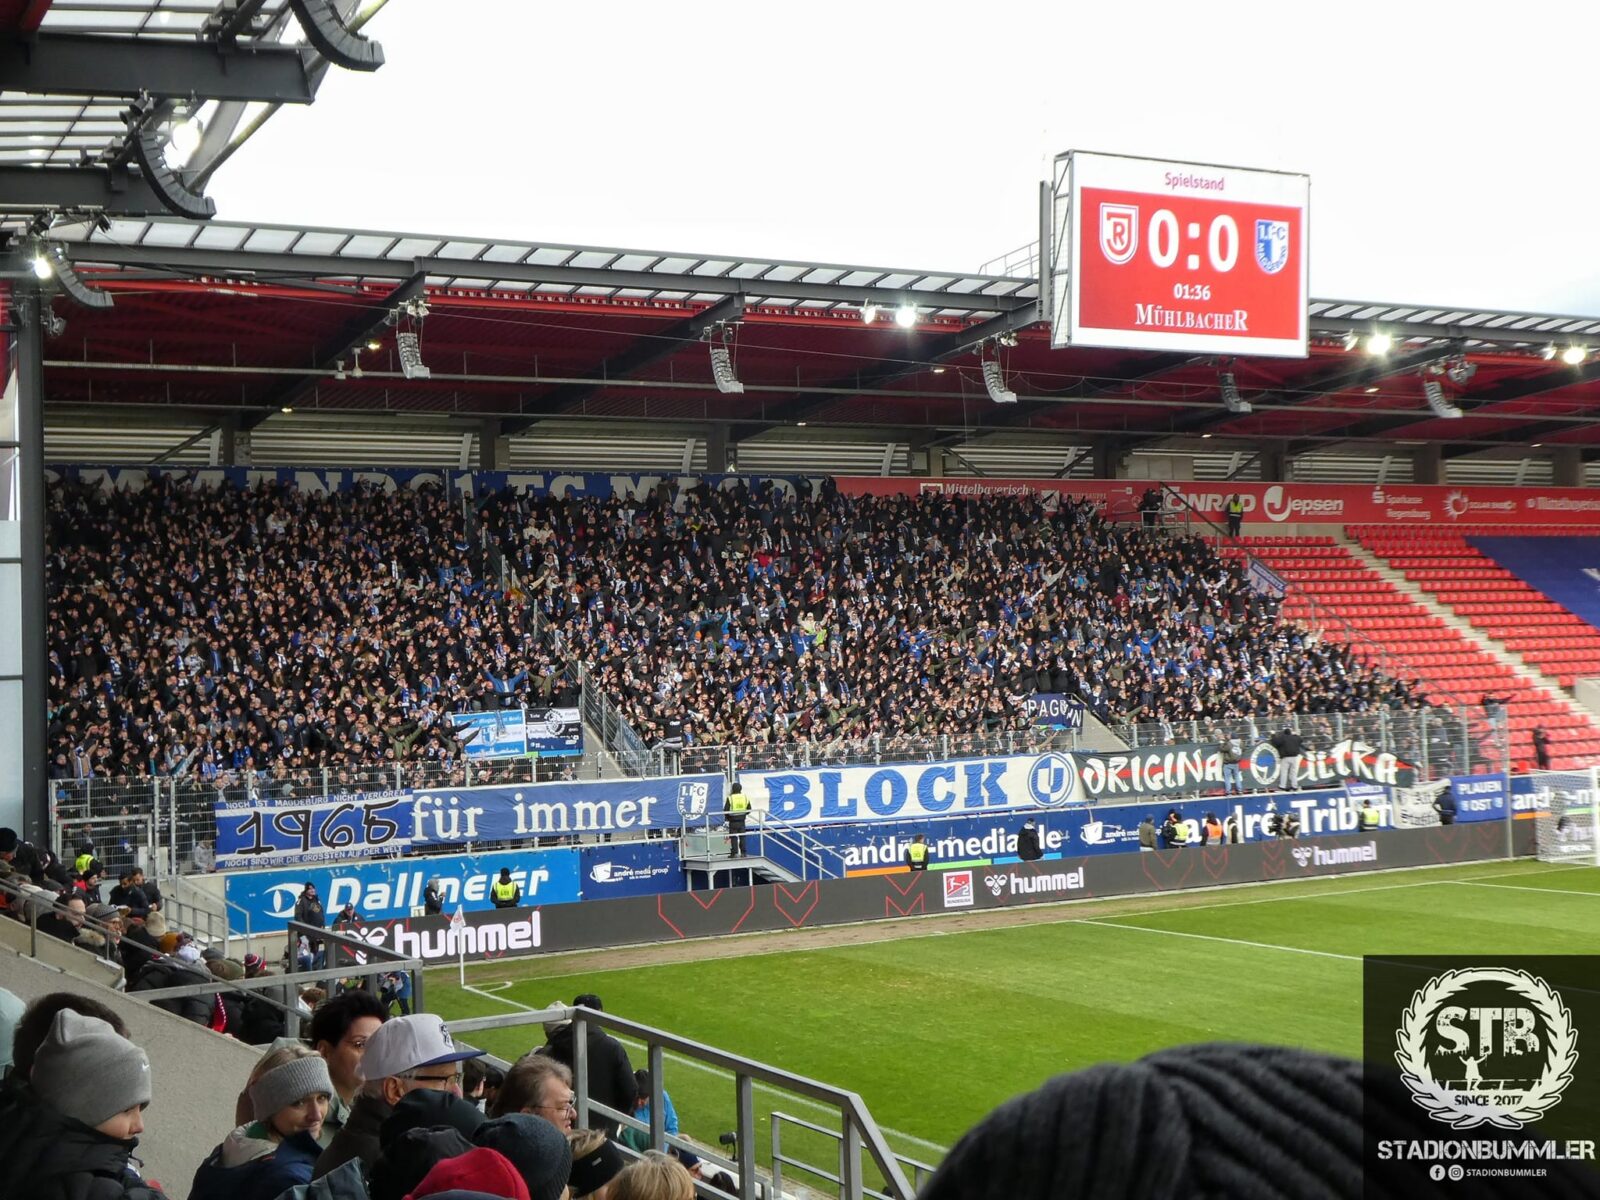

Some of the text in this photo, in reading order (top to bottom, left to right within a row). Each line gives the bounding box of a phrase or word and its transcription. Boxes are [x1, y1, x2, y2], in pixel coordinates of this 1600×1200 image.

[1165, 172, 1225, 191] Spielstand
[1148, 208, 1239, 273] 0:0
[1173, 283, 1211, 301] 01:36
[1135, 303, 1248, 331] MÜHLBACHER
[1263, 485, 1344, 522] Jepsen
[1082, 749, 1230, 794] ORIGINA
[225, 789, 406, 810] NOCH IST MAGDEBURG NICHT VERLOREN
[764, 762, 1008, 822] BLOCK
[1456, 781, 1503, 795] PLAUEN
[411, 792, 657, 841] für immer
[1470, 798, 1492, 811] OST
[236, 798, 400, 855] 1965
[225, 859, 249, 868] NOCH
[251, 858, 269, 866] SIND
[270, 857, 283, 865] WIR
[287, 856, 300, 864] DIE
[364, 847, 380, 856] DER
[383, 845, 403, 854] WELT
[845, 824, 1062, 866] andr-mediade
[1314, 840, 1377, 865] hummel
[1010, 867, 1084, 895] hummel
[394, 911, 542, 960] hummel
